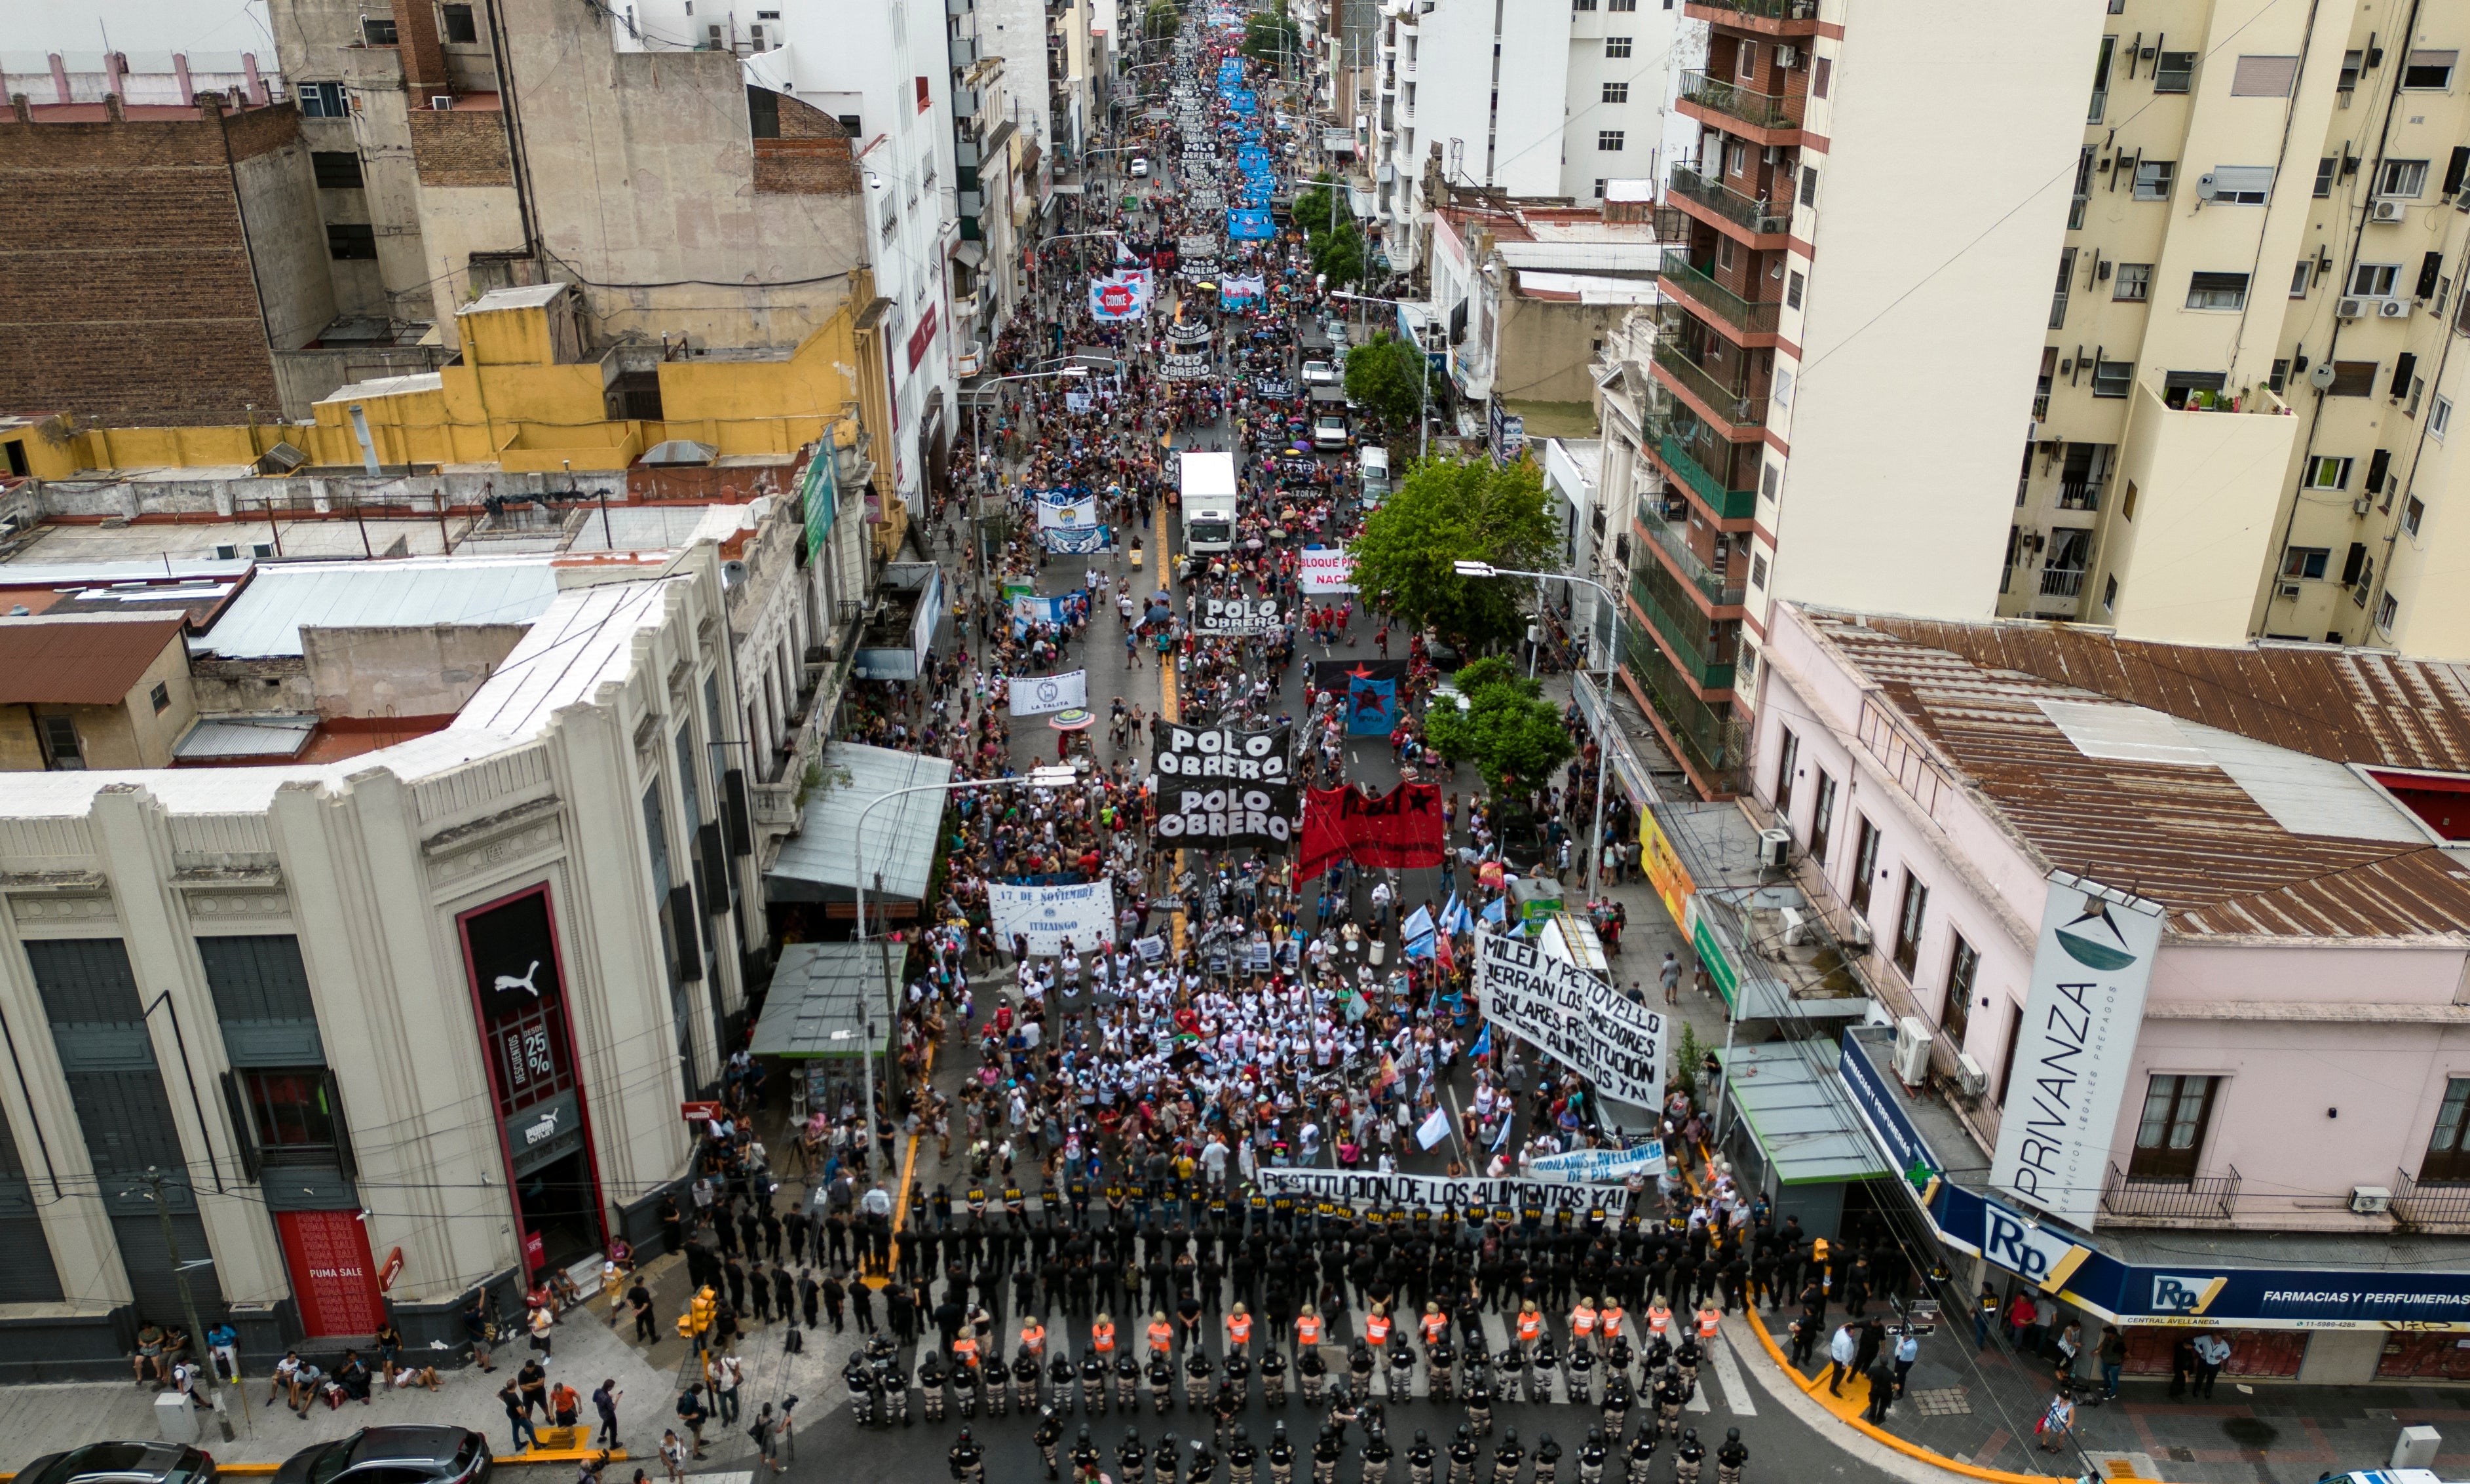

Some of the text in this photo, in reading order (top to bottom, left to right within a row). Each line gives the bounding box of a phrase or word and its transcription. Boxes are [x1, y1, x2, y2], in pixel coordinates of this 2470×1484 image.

[1185, 143, 1215, 151] POLO
[1180, 235, 1216, 248] POLO
[1179, 243, 1218, 254] OBRERO
[1181, 265, 1220, 275] OBRERO
[1105, 294, 1127, 307] COOKE
[1168, 324, 1208, 338] OBRERO
[1165, 354, 1203, 366] POLO
[1160, 364, 1209, 377] OBRERO
[1301, 558, 1339, 567] BLOQUE
[1207, 599, 1277, 618] POLO
[1204, 615, 1280, 628] OBRERO
[1043, 700, 1069, 709] TALITA
[1171, 727, 1272, 757] POLO
[1158, 752, 1283, 780] OBRERO
[1181, 788, 1270, 815] POLO
[1158, 811, 1289, 841] OBRERO
[1000, 887, 1095, 902] 17 DE NOVIEMBRE
[1483, 936, 1538, 970] MILEI
[1545, 955, 1557, 976] Y
[1559, 962, 1660, 1034] PETOVELLO
[1558, 991, 1583, 1012] LOS
[1492, 997, 1511, 1021] DE
[524, 1023, 542, 1037] DESDE
[525, 1032, 546, 1057] 25
[508, 1034, 525, 1084] DESCUENTOS
[2014, 983, 2097, 1203] PRIVANZA
[2059, 985, 2117, 1212] SERVICIOS LEGALES PREPAGOS
[1844, 1050, 1871, 1098] FARMACIAS
[1870, 1090, 1875, 1103] Y
[1874, 1099, 1910, 1158] PERFUMERIAS
[528, 1130, 554, 1145] OUTLET
[1597, 1143, 1663, 1166] AVELLANEDA
[1567, 1166, 1612, 1182] DE PIE
[968, 1189, 984, 1199] PFA
[1005, 1189, 1021, 1200] PFA
[1398, 1177, 1423, 1205] DE
[1430, 1182, 1470, 1206] LOS
[1476, 1181, 1586, 1208] ALIMENTOS
[1591, 1189, 1625, 1210] YA!
[1251, 1198, 1266, 1207] PFA
[1275, 1199, 1291, 1209] PFA
[1318, 1203, 1334, 1214] PFA
[1337, 1207, 1352, 1219] PFA
[1470, 1208, 1485, 1219] PFA
[1525, 1209, 1541, 1219] PFA
[1592, 1209, 1604, 1219] PFA
[296, 1212, 351, 1223] PUMA SALE
[1367, 1212, 1384, 1223] PFA
[1390, 1211, 1405, 1221] PFA
[1496, 1211, 1512, 1221] PFA
[1559, 1211, 1572, 1221] PFA
[298, 1221, 352, 1232] PUMA SALE
[1670, 1217, 1685, 1228] PFA
[300, 1230, 355, 1241] PUMA SALE
[303, 1240, 356, 1250] PUMA SALE
[306, 1249, 359, 1259] PUMA SALE
[308, 1259, 360, 1268] PUMA SALE
[310, 1267, 363, 1278] PUMA SALE
[312, 1277, 366, 1287] PUMA SALE
[314, 1286, 366, 1296] PUMA SALE
[317, 1295, 369, 1305] PUMA SALE
[2263, 1291, 2470, 1304] FARMACIAS Y PERFUMERIAS
[319, 1304, 371, 1314] PUMA SALE
[350, 1313, 373, 1322] SALE
[324, 1323, 351, 1331] PUMA
